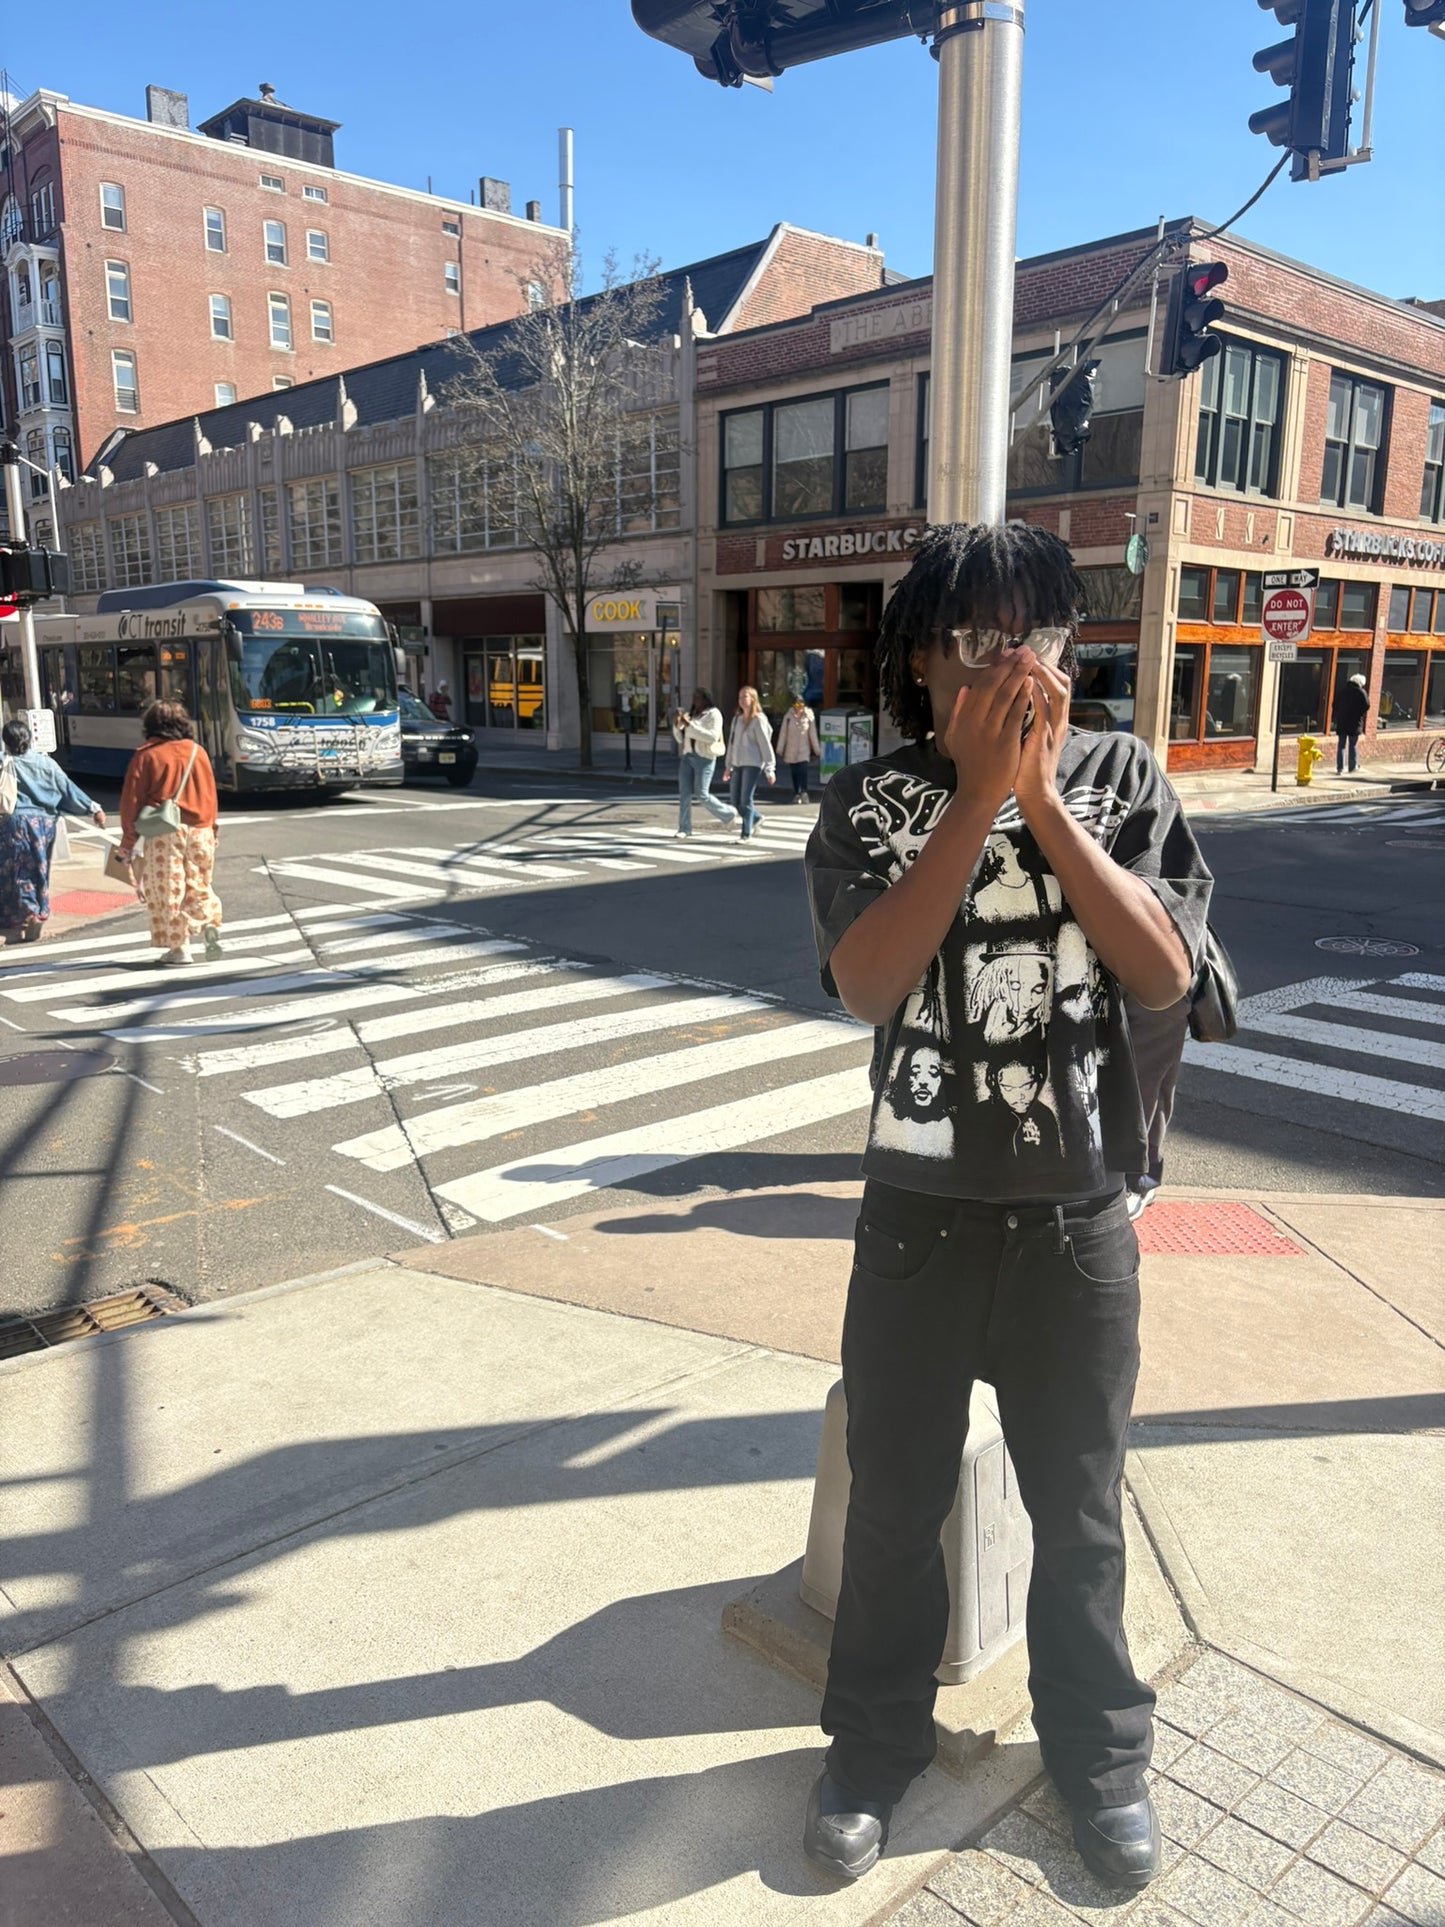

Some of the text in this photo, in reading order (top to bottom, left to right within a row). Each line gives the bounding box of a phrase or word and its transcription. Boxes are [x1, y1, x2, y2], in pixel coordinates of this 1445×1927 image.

[843, 315, 882, 342] THE
[1333, 527, 1415, 559] STARBUCKS
[1271, 574, 1308, 585] ONE WAY
[1270, 599, 1304, 609] DO NOT
[145, 612, 187, 637] transit
[1271, 622, 1299, 631] ENTER
[250, 717, 276, 727] 1758
